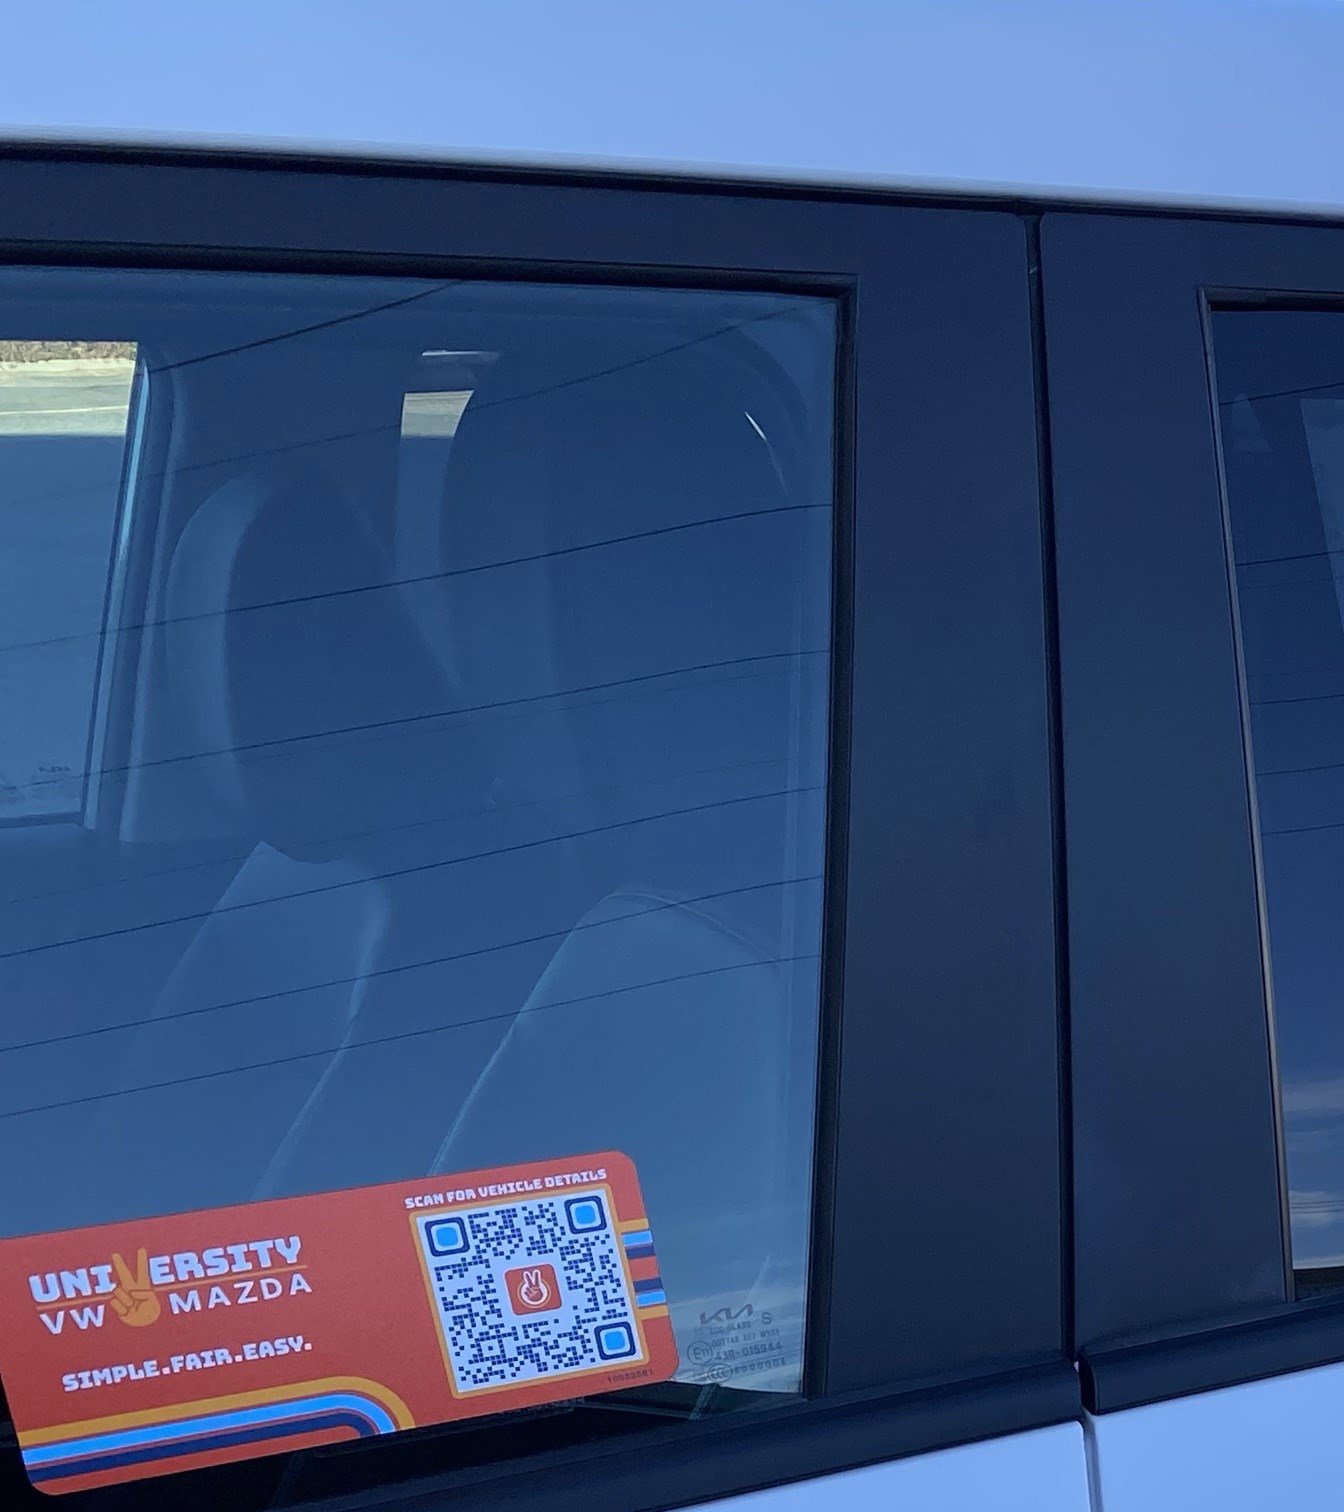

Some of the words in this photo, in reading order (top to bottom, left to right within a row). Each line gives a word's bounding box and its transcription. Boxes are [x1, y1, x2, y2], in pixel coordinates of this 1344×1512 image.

[404, 1192, 445, 1210] SCAN
[447, 1188, 476, 1205] FOR
[477, 1178, 542, 1200] VEHICLE
[544, 1168, 608, 1192] DETAILS
[28, 1235, 303, 1304] UNIVERSITY
[38, 1304, 106, 1336] VW
[170, 1272, 313, 1316] MAZDA
[699, 1304, 754, 1325] KIA
[61, 1335, 313, 1392] SIMPLE.FAIR.EASY.
